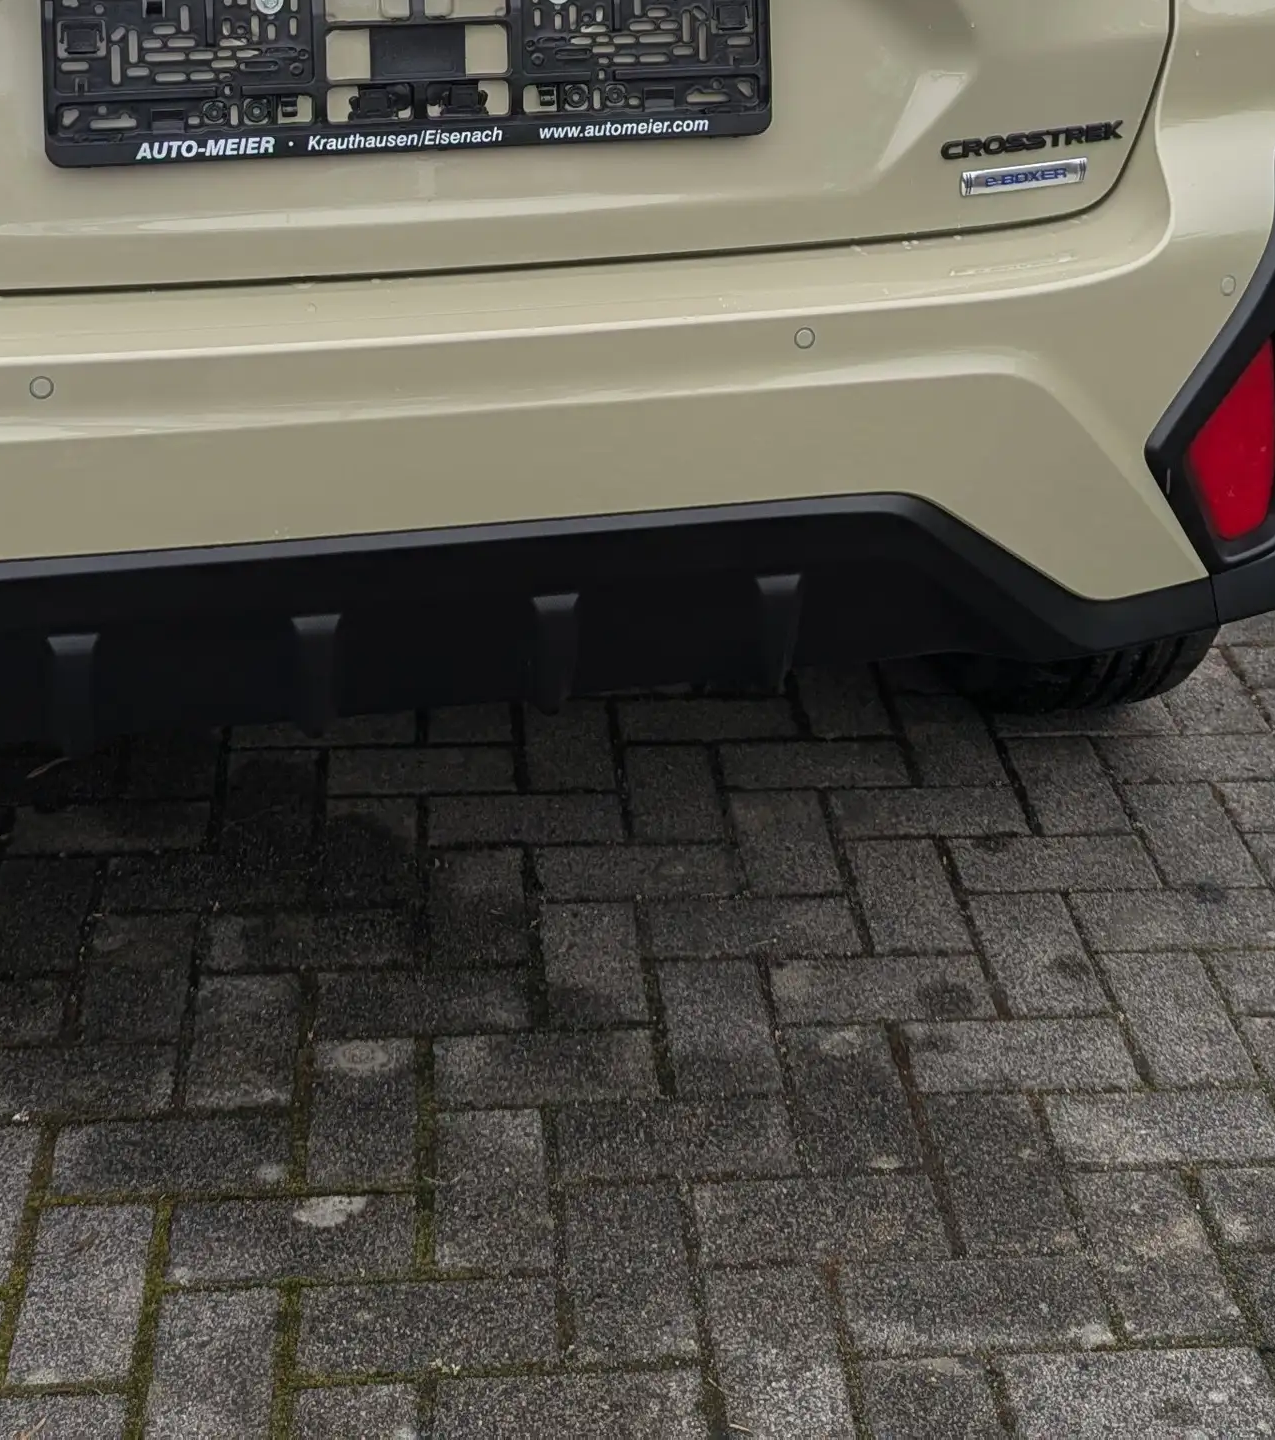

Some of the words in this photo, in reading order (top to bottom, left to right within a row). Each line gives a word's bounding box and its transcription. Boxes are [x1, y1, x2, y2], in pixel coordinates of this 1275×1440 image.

[135, 136, 276, 160] AUTO-MEIER
[307, 126, 503, 152] Krauthausen/Eisenach
[539, 117, 710, 140] www.automeier.com
[940, 119, 1124, 160] CROSSTREK
[985, 167, 1068, 188] e-BOXER
